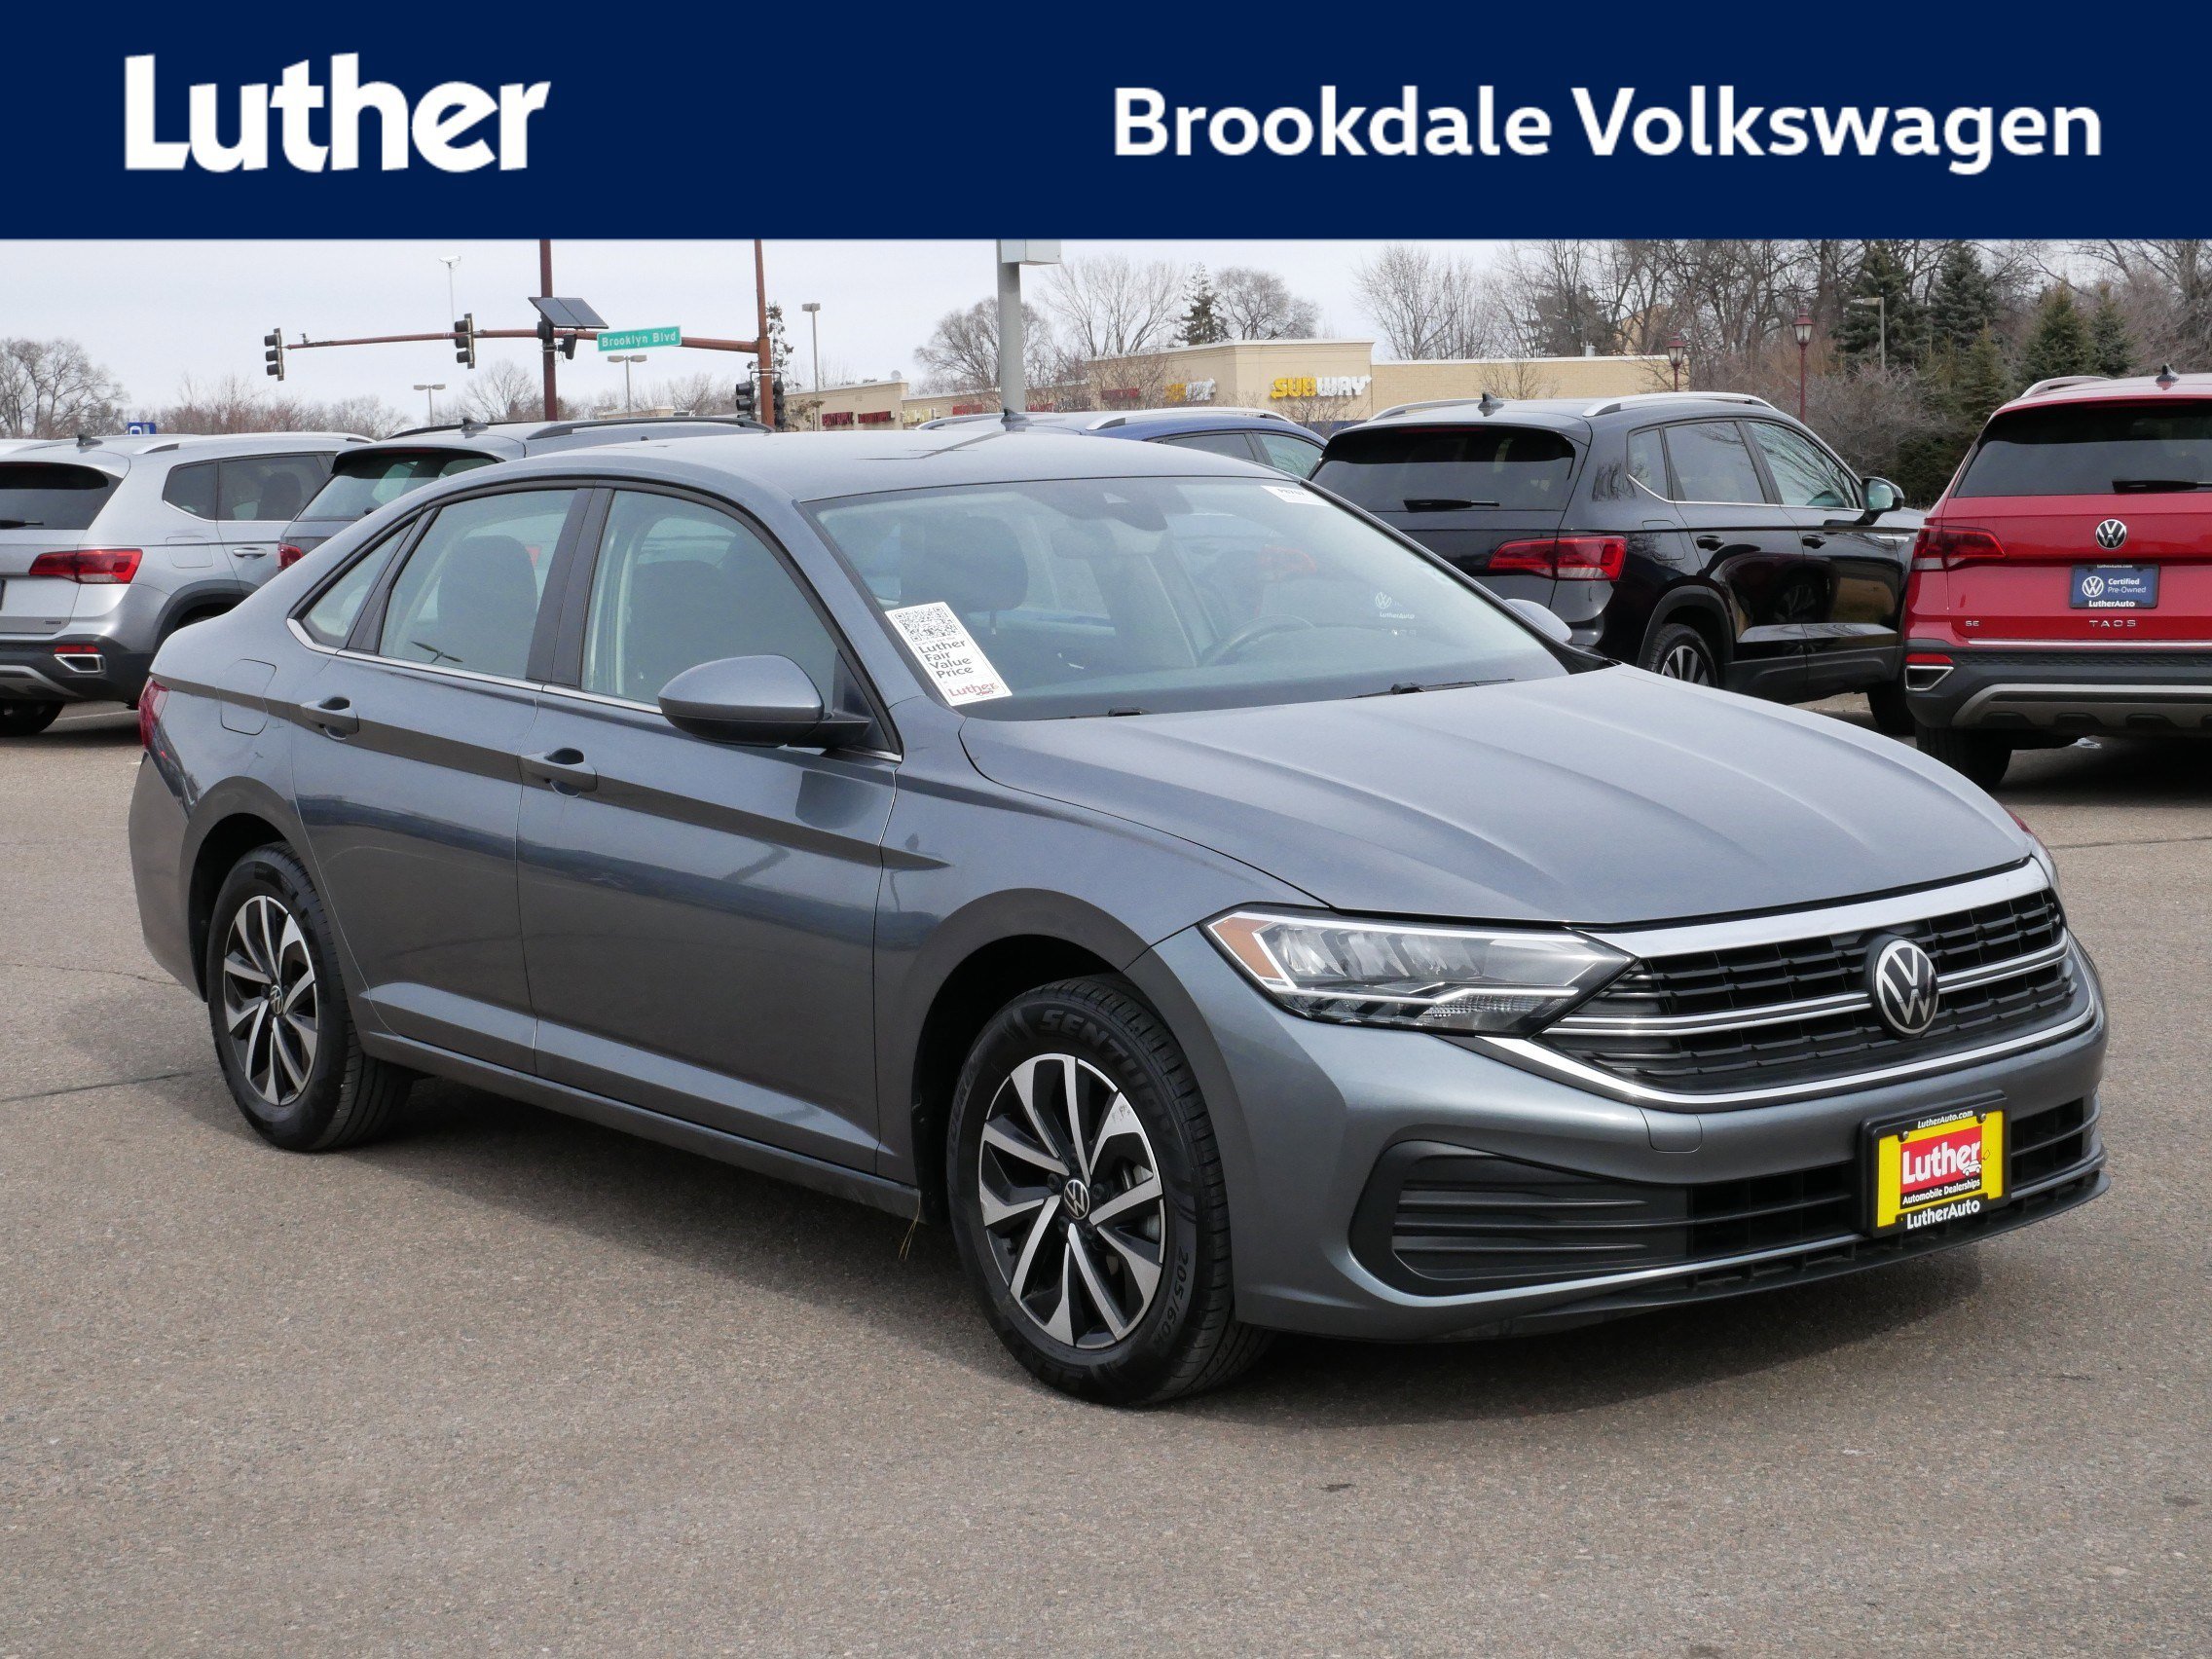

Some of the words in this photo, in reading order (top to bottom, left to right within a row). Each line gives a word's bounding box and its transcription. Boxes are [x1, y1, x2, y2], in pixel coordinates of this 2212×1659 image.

[602, 334, 648, 348] Brooklyn
[652, 331, 677, 343] Blvd
[1270, 374, 1373, 399] SUBWAY
[2108, 577, 2140, 586] Certified
[2089, 619, 2137, 628] TAOS
[917, 639, 967, 654] Luther
[924, 651, 951, 663] Fair
[930, 657, 973, 670] Value
[936, 666, 975, 680] Price
[948, 682, 996, 697] Luther
[1917, 1110, 1974, 1129] LutherAuto.com
[1901, 1140, 1982, 1185] Luther
[1901, 1187, 1943, 1205] Automobile
[1943, 1178, 1981, 1197] Dealerships
[1906, 1198, 1981, 1230] LutherAuto
